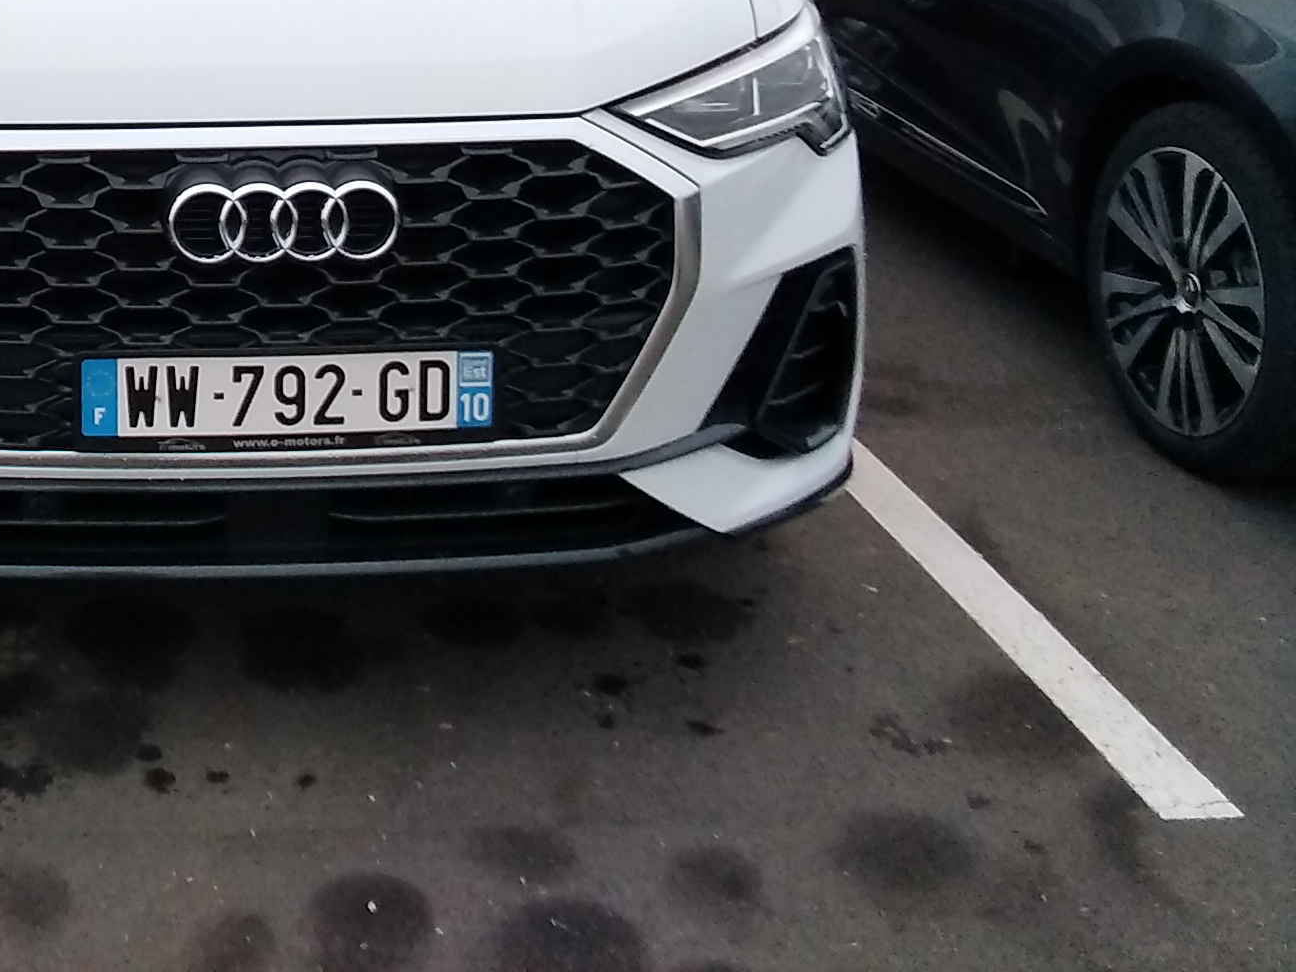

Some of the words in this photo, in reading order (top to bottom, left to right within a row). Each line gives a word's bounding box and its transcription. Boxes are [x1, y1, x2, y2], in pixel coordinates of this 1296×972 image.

[124, 359, 452, 428] WW-792-GD
[459, 392, 490, 423] 10
[93, 407, 106, 426] F
